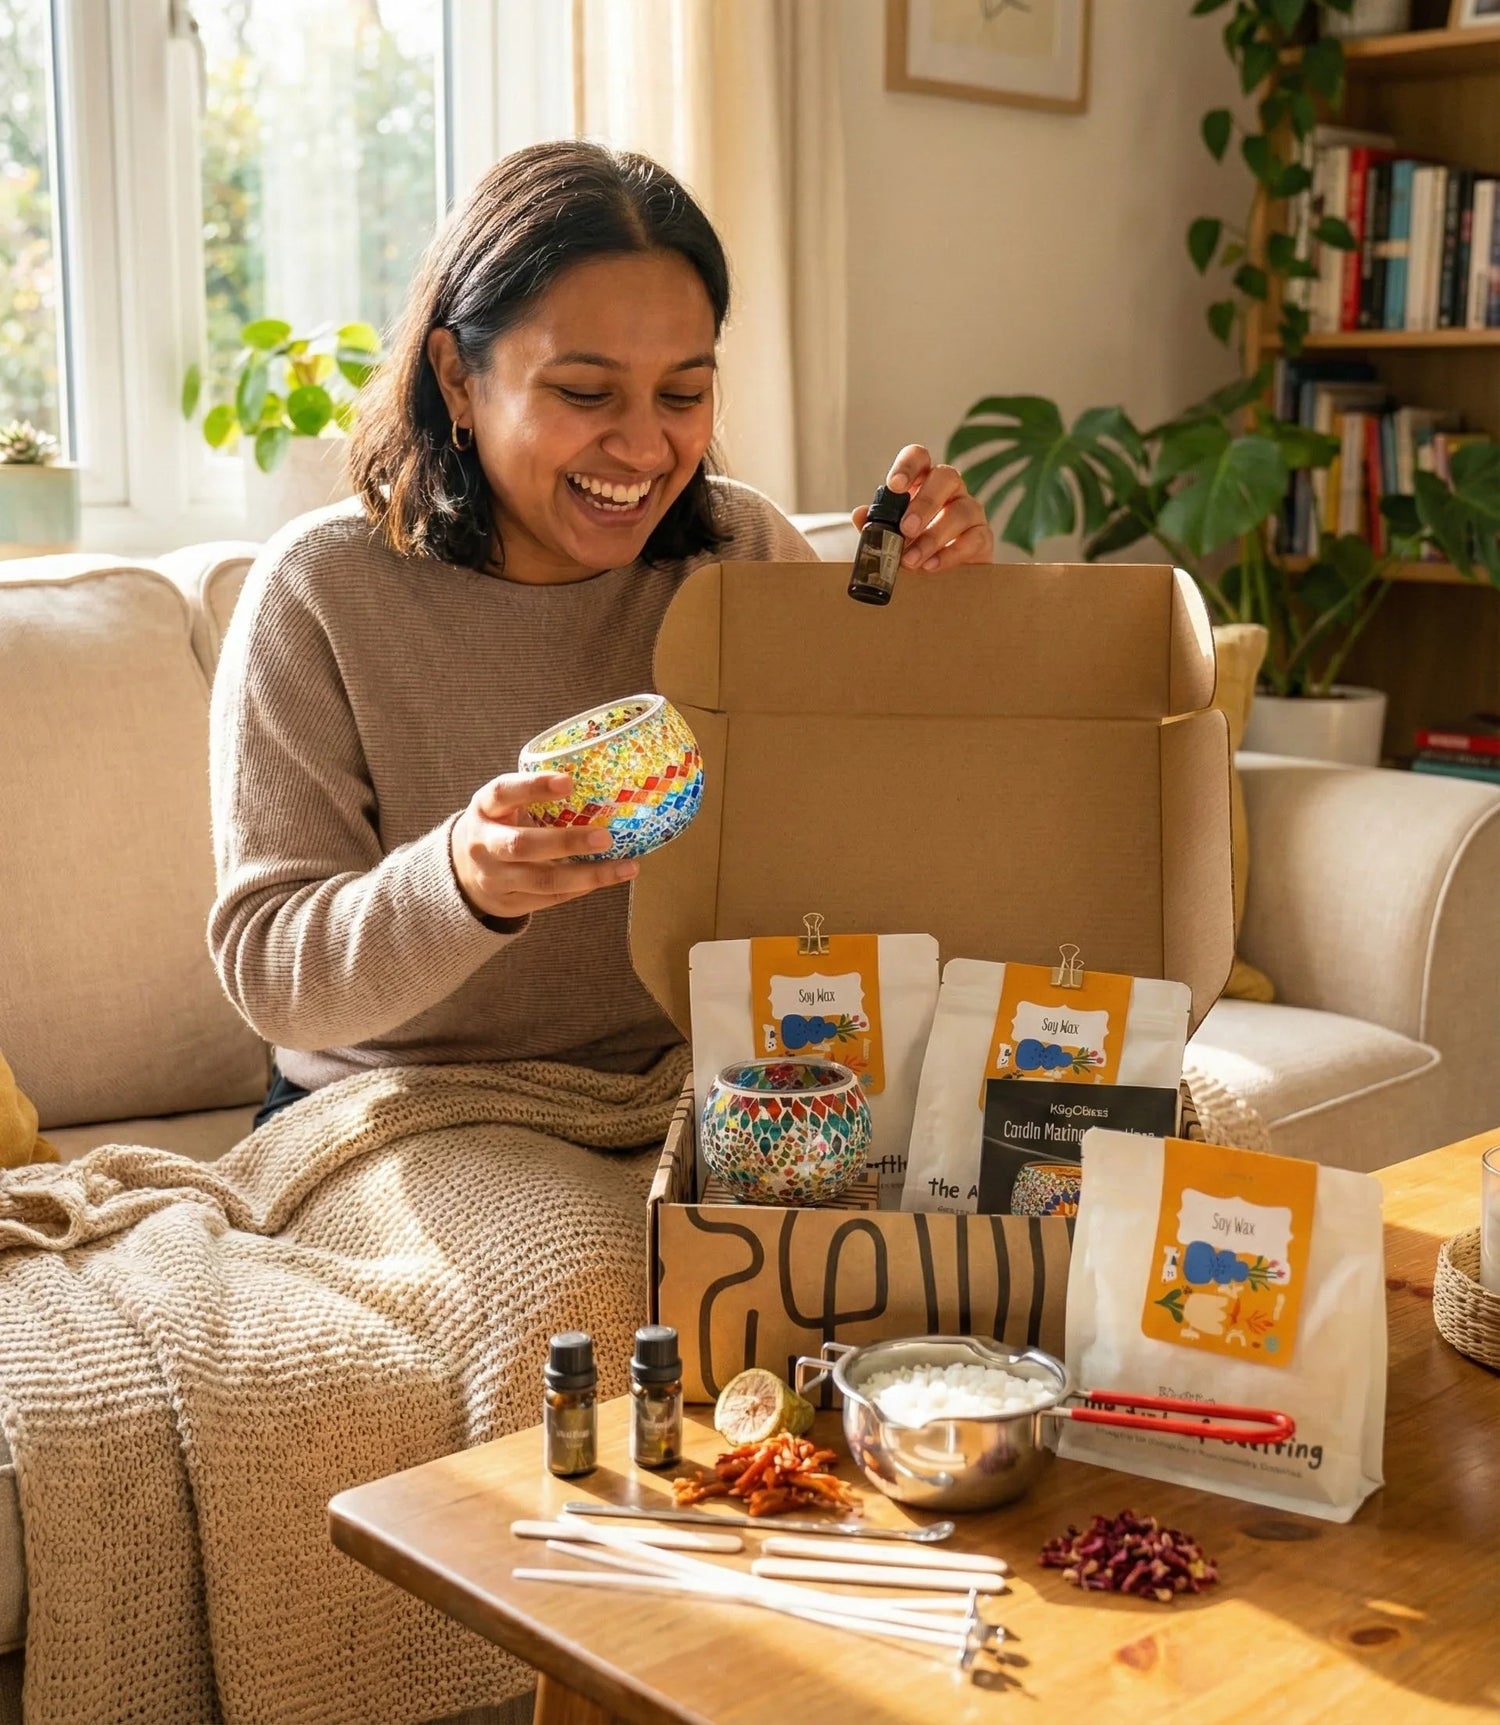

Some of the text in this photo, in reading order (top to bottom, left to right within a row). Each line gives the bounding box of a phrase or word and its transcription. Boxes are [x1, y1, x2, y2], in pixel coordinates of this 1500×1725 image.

[798, 987, 836, 1006] Soy Wax
[1041, 1017, 1080, 1035] Soy Wax
[927, 1177, 960, 1199] the
[1211, 1212, 1256, 1236] Soy Wax
